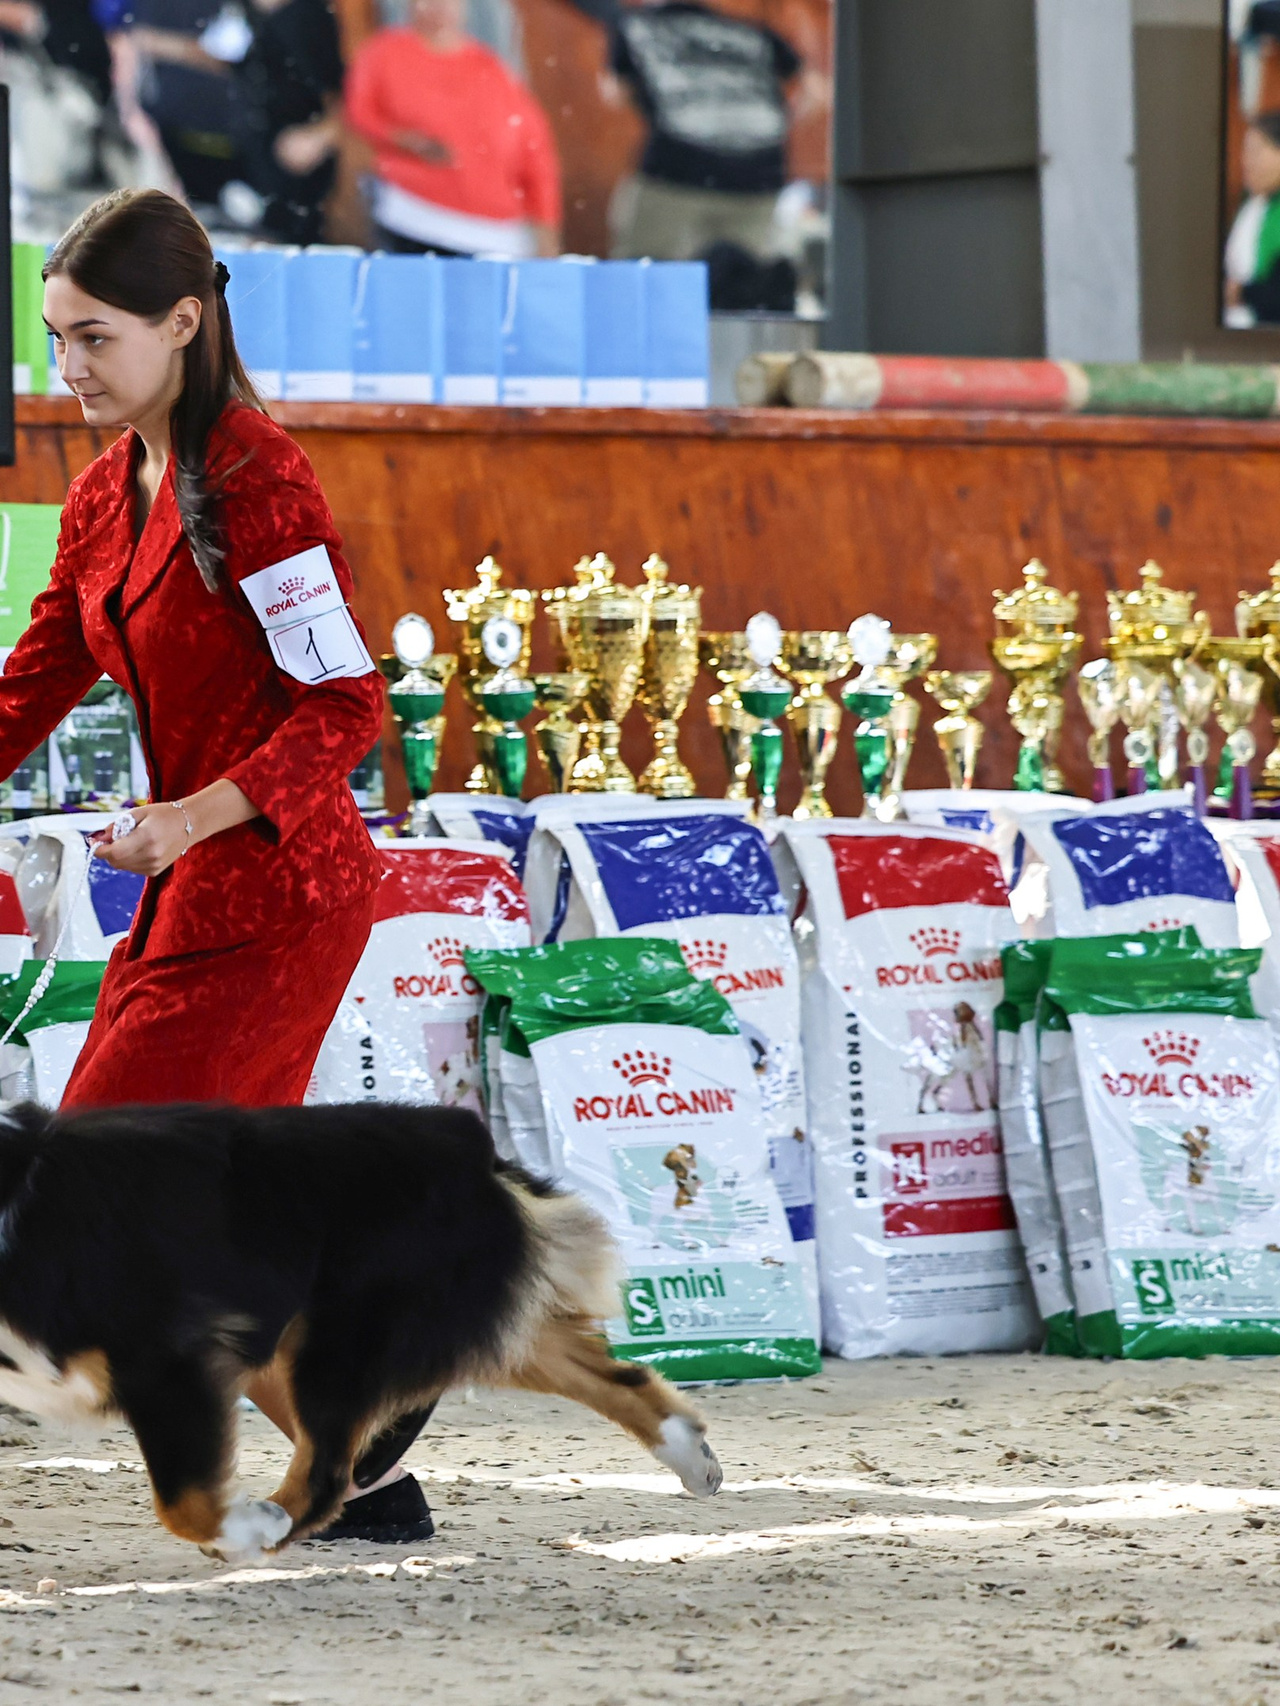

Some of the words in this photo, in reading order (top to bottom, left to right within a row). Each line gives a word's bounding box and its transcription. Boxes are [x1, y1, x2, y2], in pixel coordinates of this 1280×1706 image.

[265, 597, 298, 617] ROYAL
[298, 581, 331, 603] CANIN
[305, 626, 346, 681] 1
[393, 975, 458, 998] ROYAL
[712, 968, 785, 995] CANIN
[573, 1093, 654, 1122] ROYAL
[656, 1088, 734, 1116] CANIN
[658, 1267, 726, 1299] mini
[1139, 1270, 1166, 1304] S
[628, 1288, 655, 1325] S
